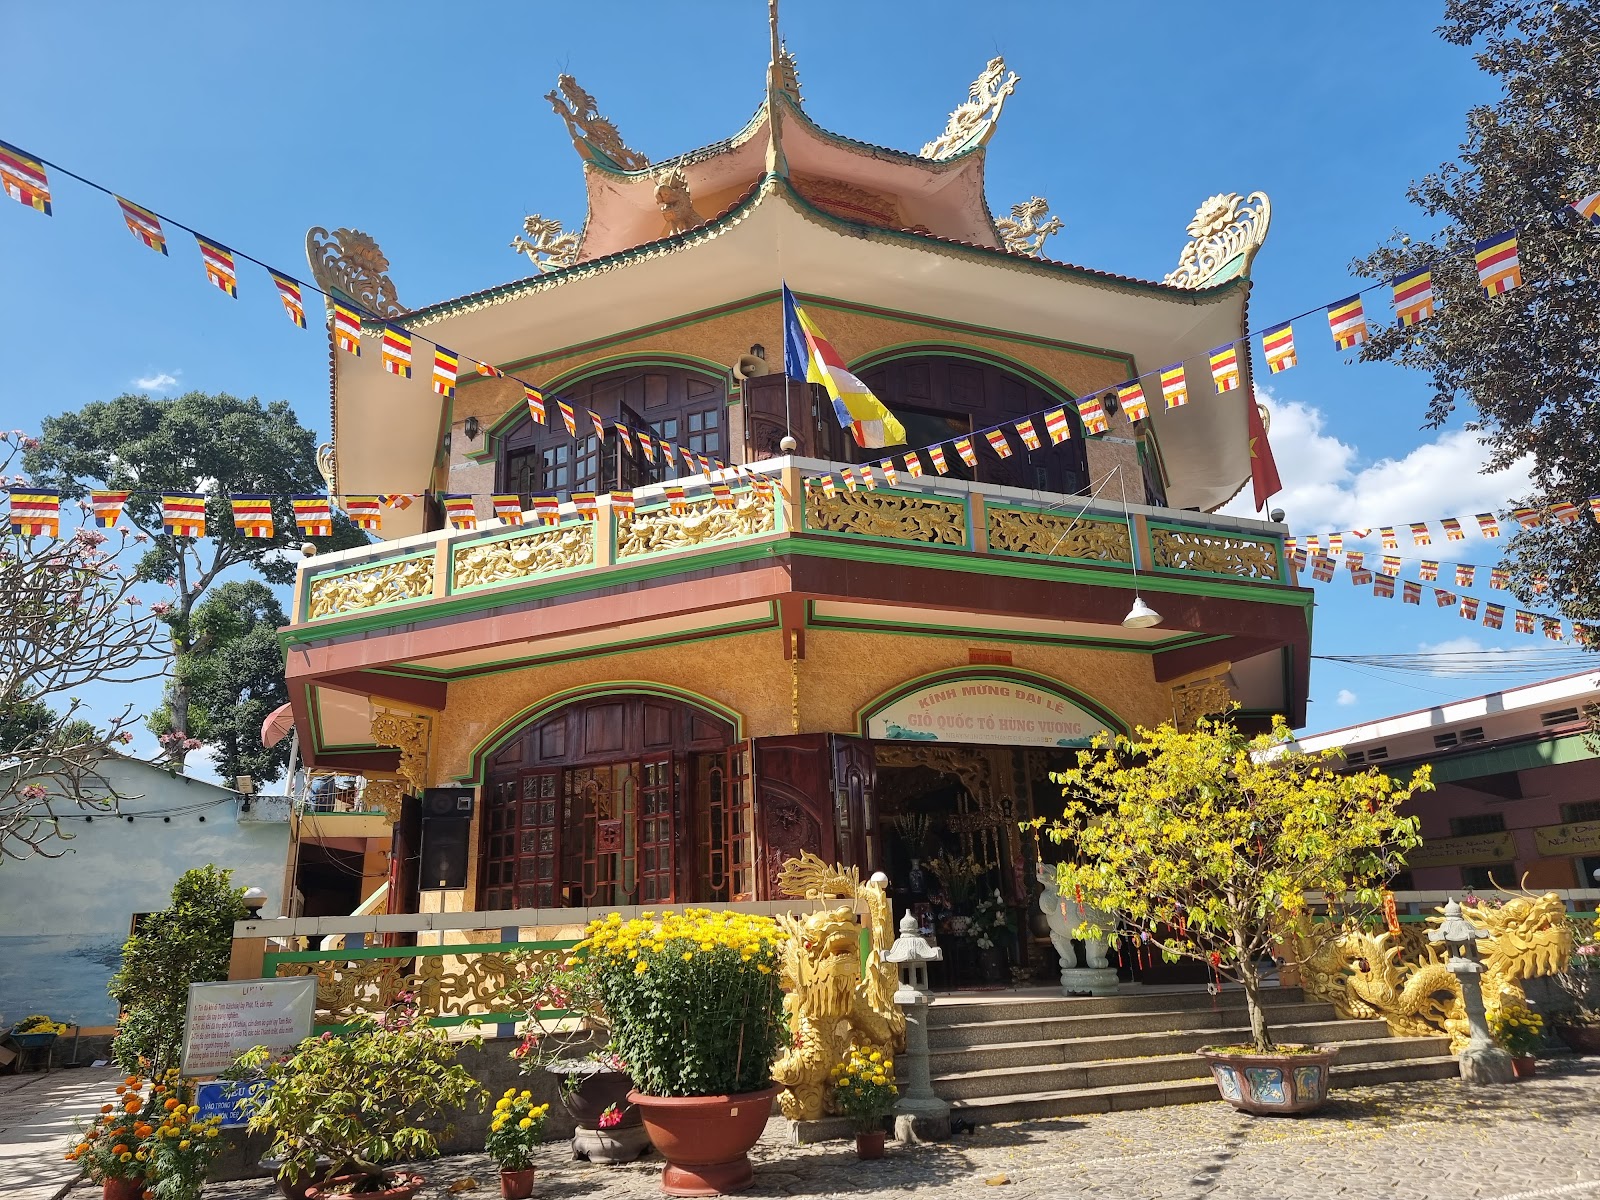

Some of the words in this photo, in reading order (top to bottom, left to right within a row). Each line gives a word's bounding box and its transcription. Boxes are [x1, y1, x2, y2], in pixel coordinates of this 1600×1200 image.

[918, 688, 957, 709] KÍNH
[962, 684, 1010, 696] MỪNG
[1014, 689, 1042, 705] ĐẠI
[1046, 699, 1065, 715] LỄ
[907, 708, 933, 727] GIỖ
[936, 712, 974, 731] QUỐC
[998, 716, 1035, 732] HÙNG
